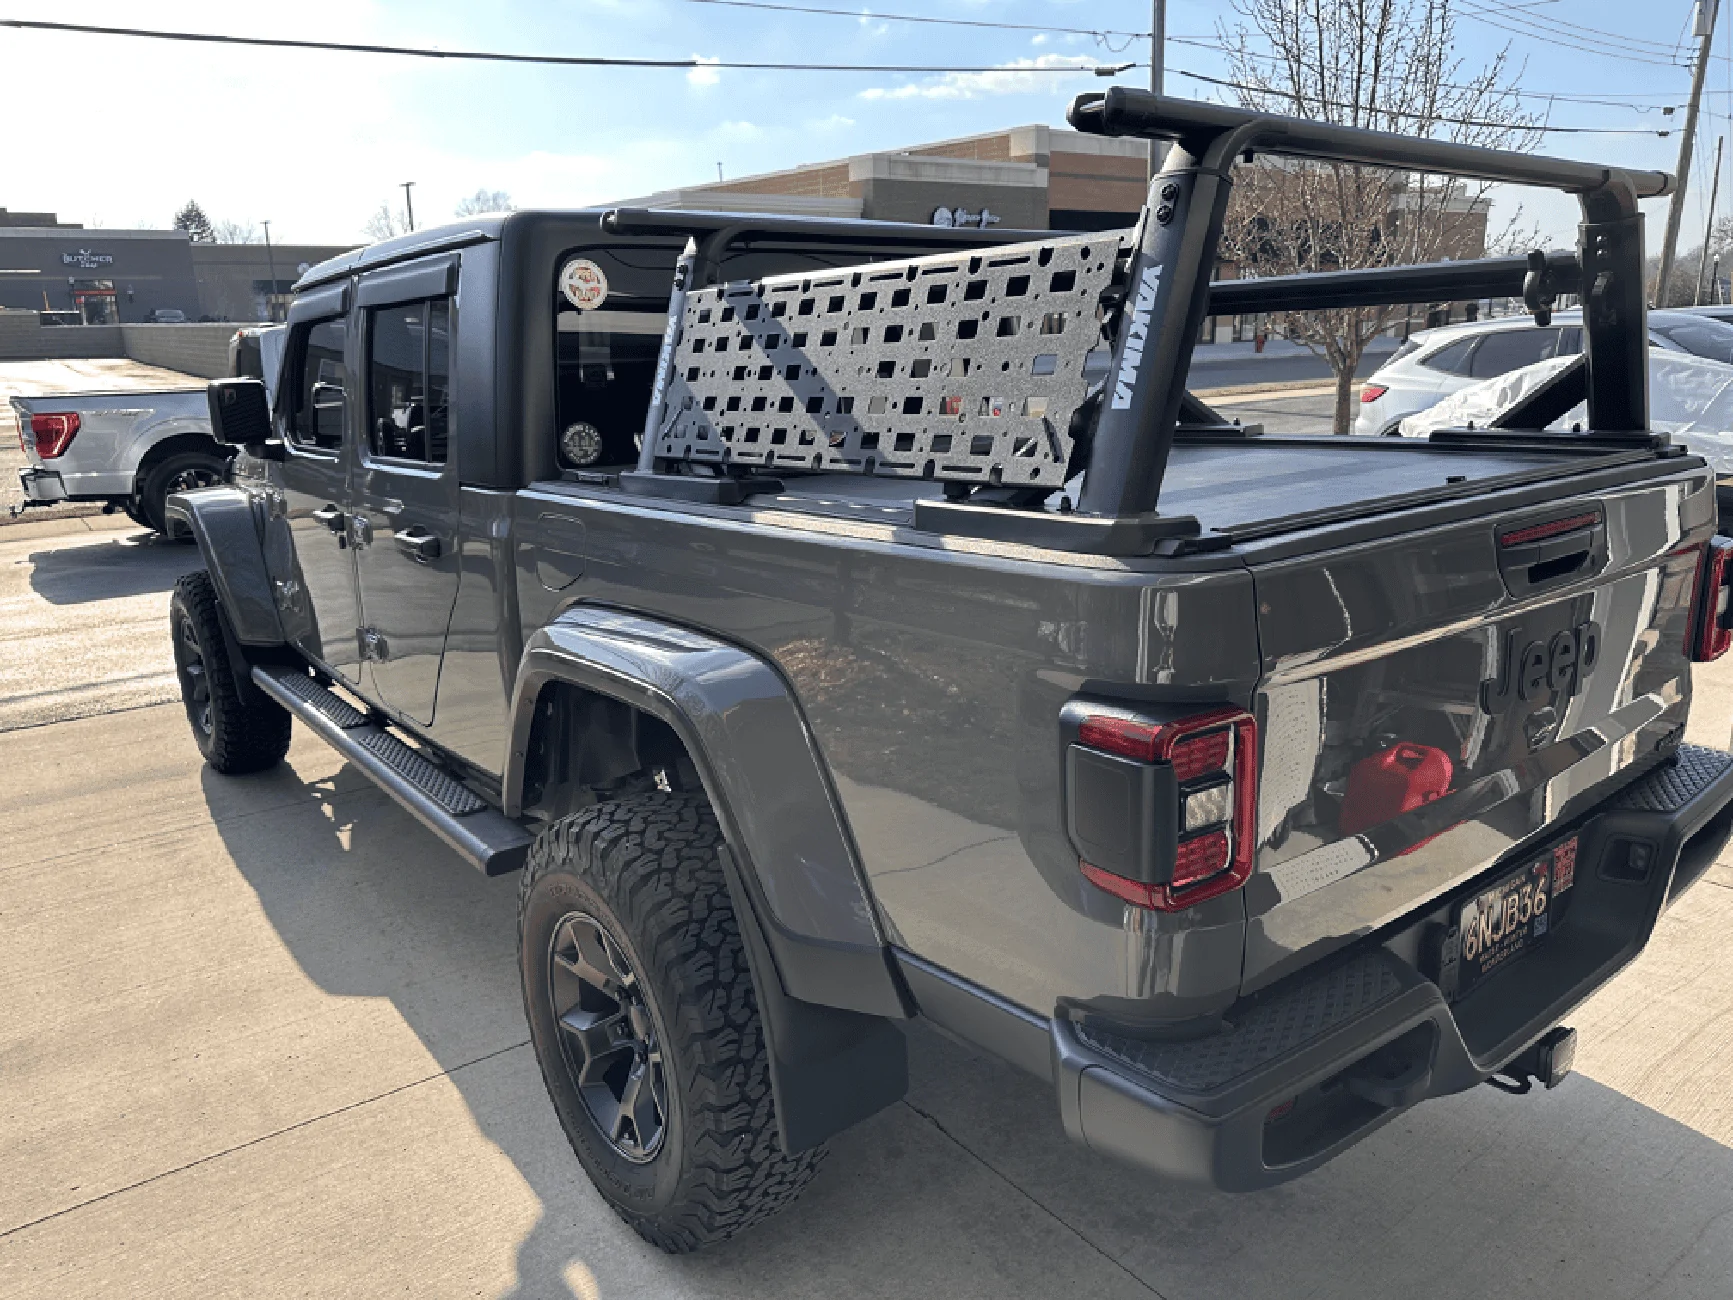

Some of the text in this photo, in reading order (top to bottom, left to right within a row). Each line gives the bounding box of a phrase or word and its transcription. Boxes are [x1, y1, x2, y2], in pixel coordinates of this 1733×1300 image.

[652, 315, 678, 407] YAKIMA
[1111, 264, 1164, 410] YAKIMA
[1480, 620, 1602, 716] Jeep
